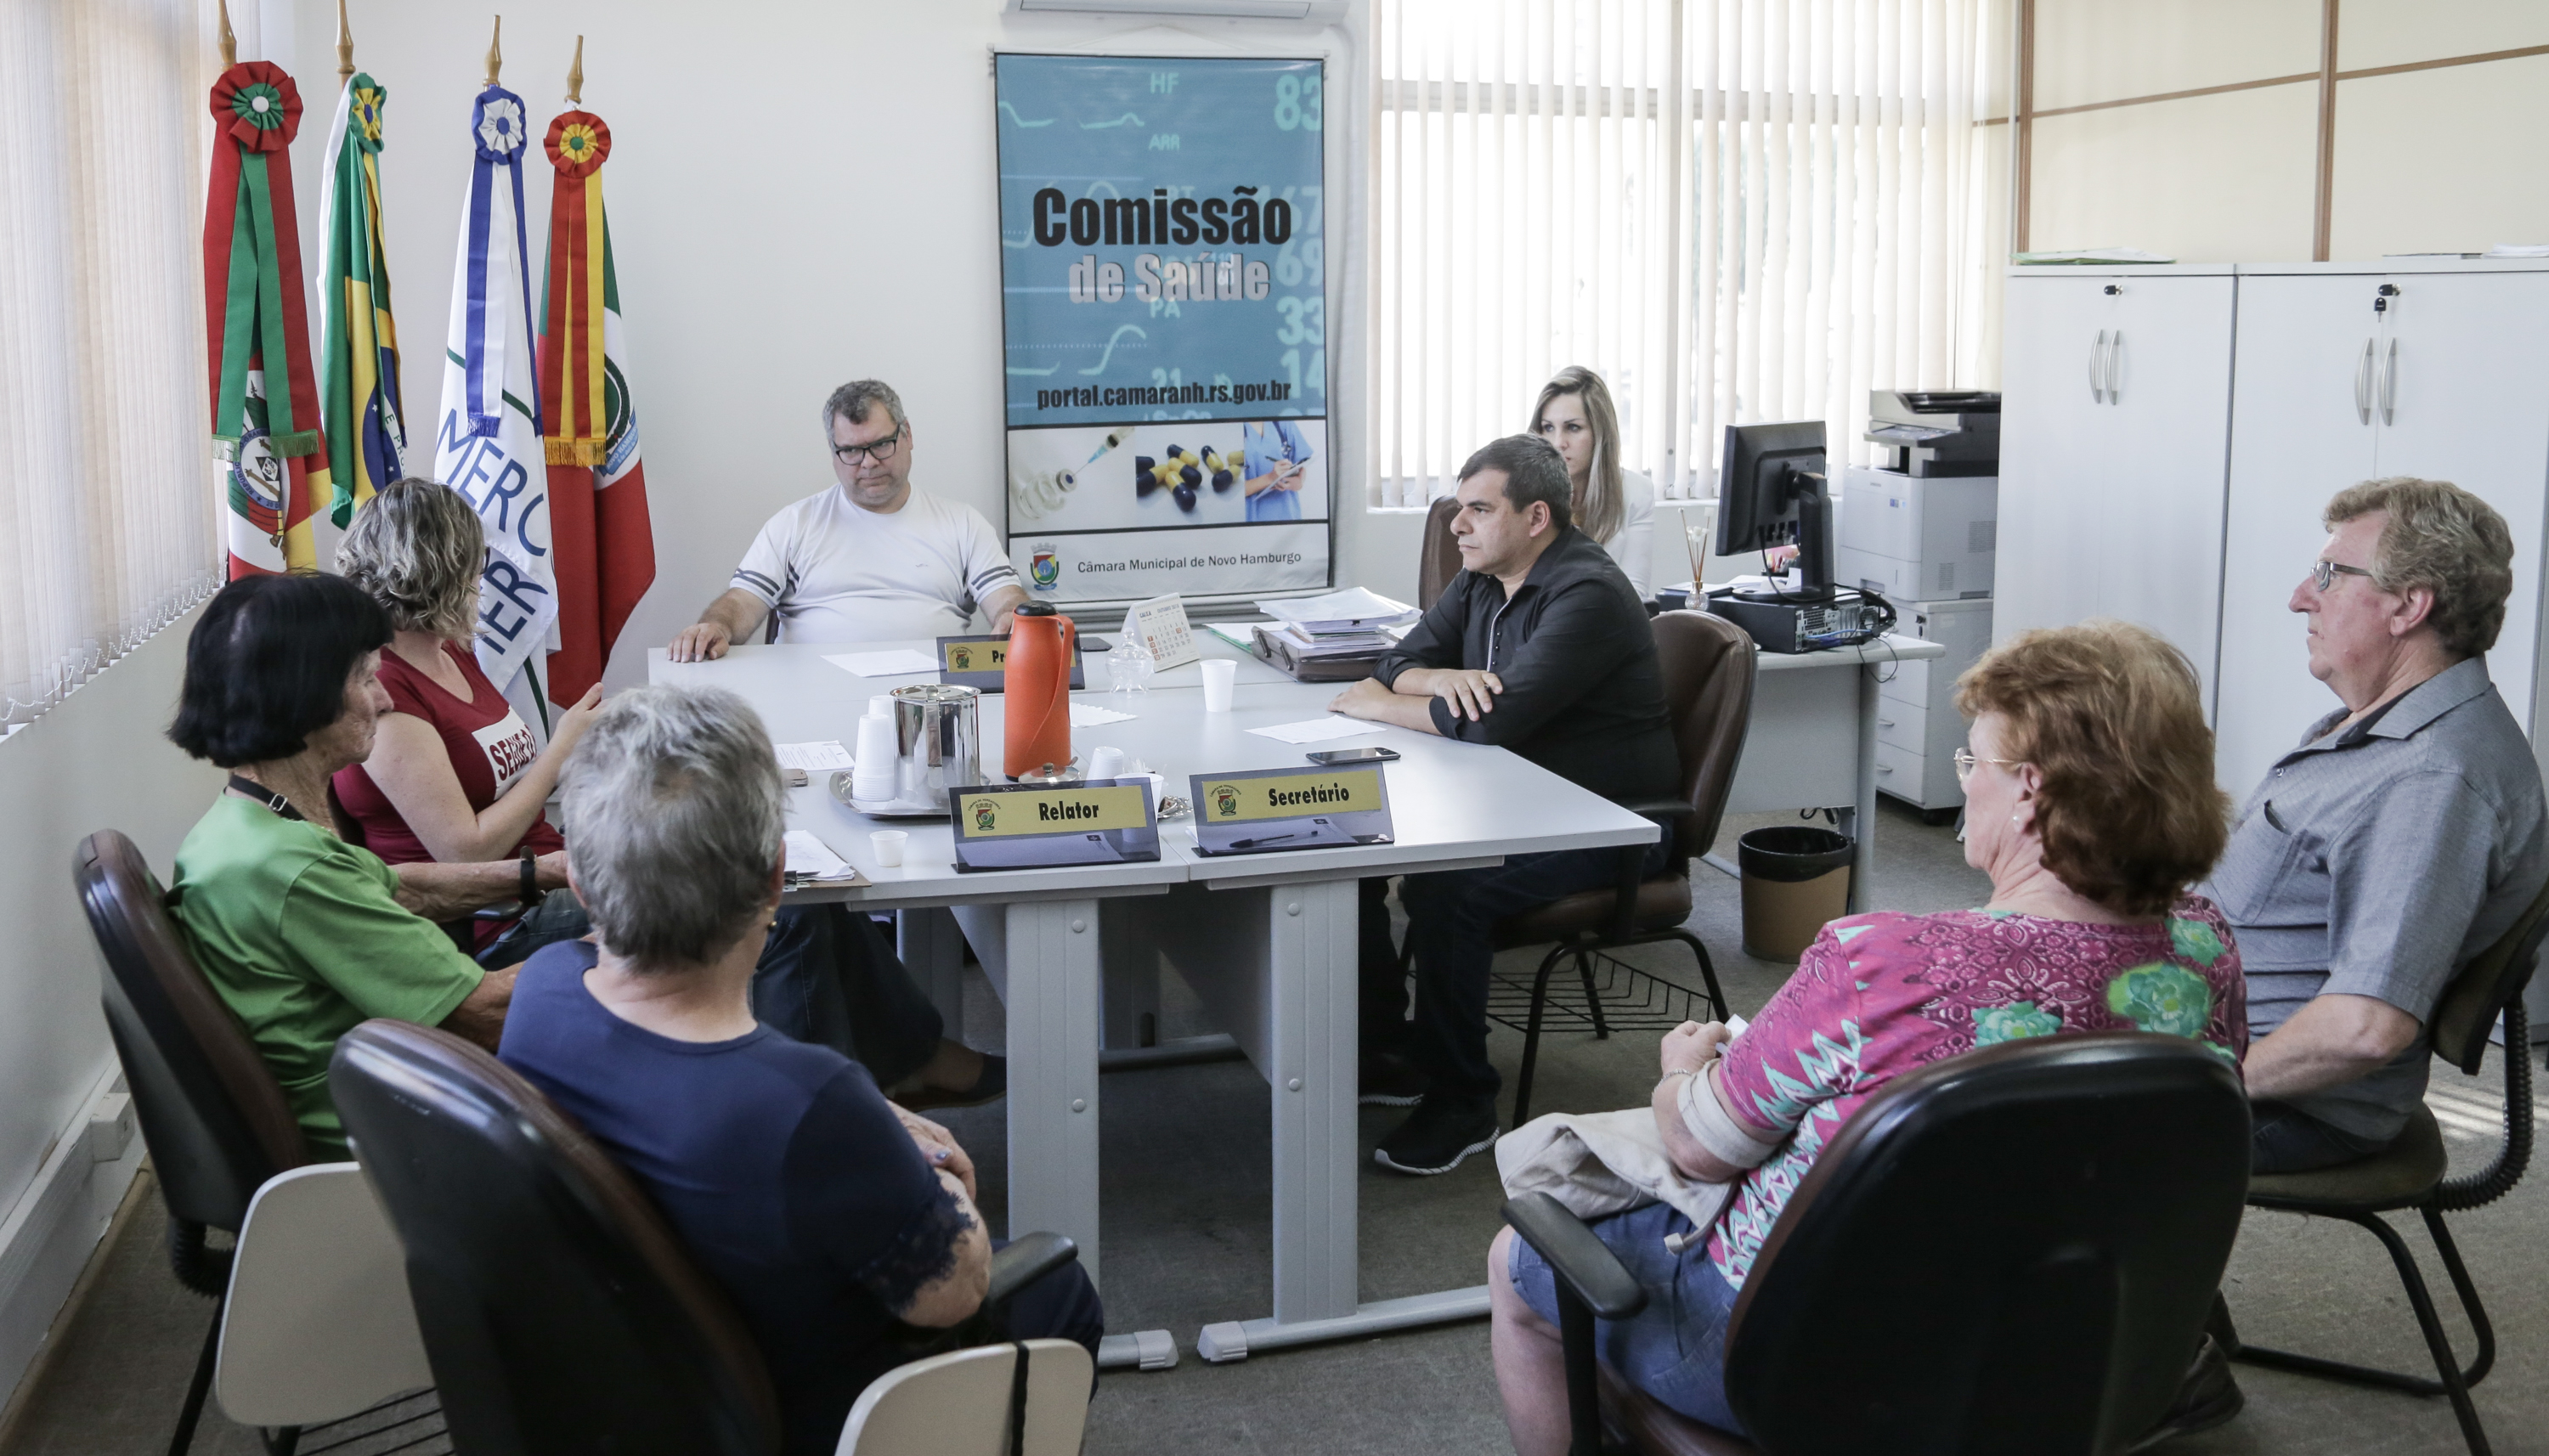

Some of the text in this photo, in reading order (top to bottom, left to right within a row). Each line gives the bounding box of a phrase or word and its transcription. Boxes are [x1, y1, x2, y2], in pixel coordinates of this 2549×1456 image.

[1150, 72, 1179, 94] HF
[1032, 185, 1291, 247] Comissão
[1068, 254, 1125, 303] de
[1133, 251, 1271, 303] Saúde
[1037, 380, 1291, 409] portal.camaranh.rs.gov.br
[1077, 550, 1302, 573] Câmara Municipal de Novo Hamburgo
[992, 650, 1006, 663] Pr
[1268, 782, 1350, 807] Secretário
[1038, 800, 1099, 821] Relator
